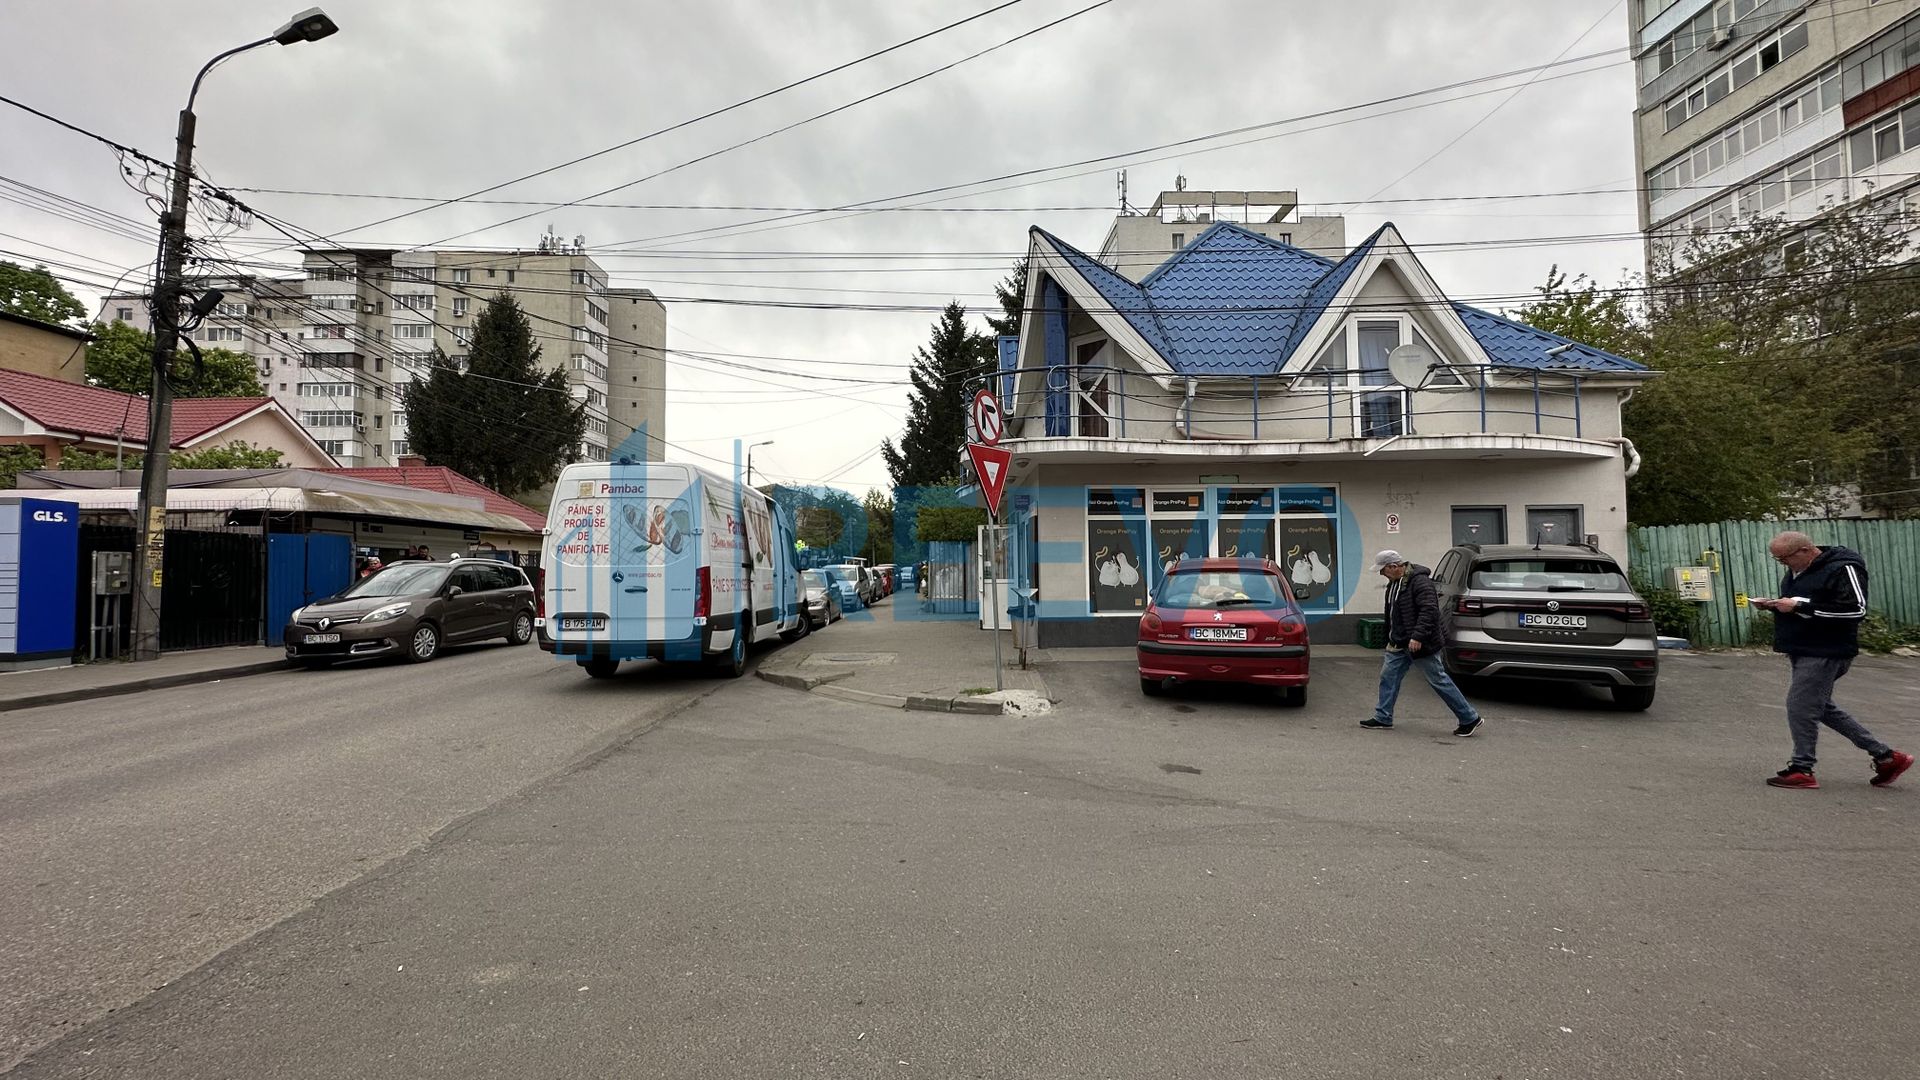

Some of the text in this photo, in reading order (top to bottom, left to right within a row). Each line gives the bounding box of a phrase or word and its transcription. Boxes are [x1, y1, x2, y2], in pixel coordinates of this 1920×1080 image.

[601, 484, 644, 494] Pambac
[568, 504, 593, 515] PÂINE
[564, 518, 605, 528] PRODUSE
[577, 532, 589, 541] DE
[1525, 615, 1585, 626] BC 02 GLC
[1195, 628, 1209, 638] BC
